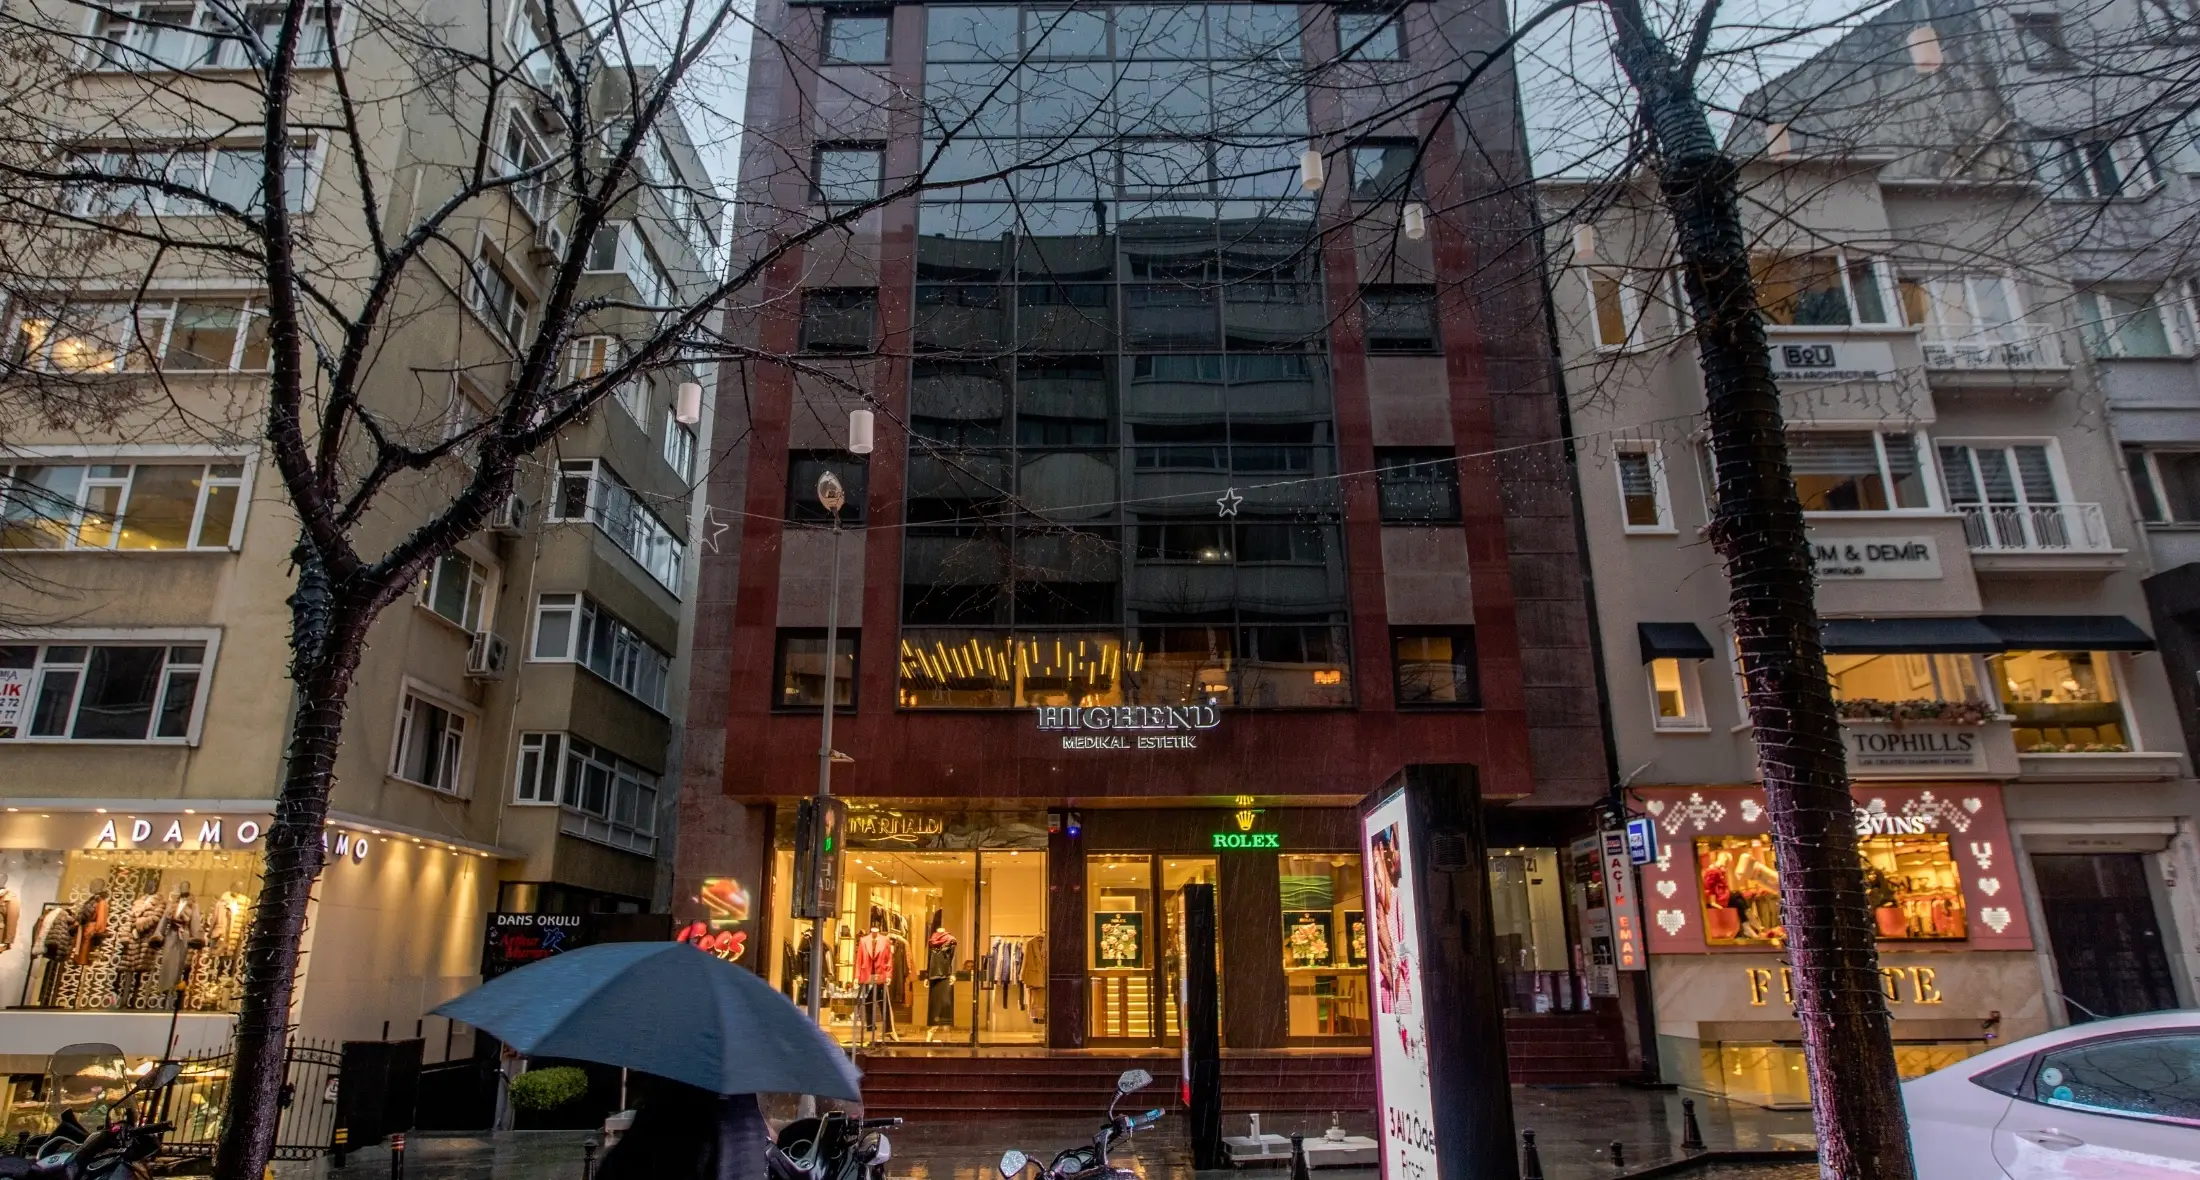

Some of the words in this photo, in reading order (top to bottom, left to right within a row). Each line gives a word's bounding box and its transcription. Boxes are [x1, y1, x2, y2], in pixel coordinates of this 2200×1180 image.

[1866, 541, 1929, 560] DEMİR
[0, 683, 22, 696] IK
[1037, 705, 1221, 729] HIGHEND
[1852, 733, 1972, 752] TOPHILLS
[97, 819, 261, 843] ADAMO
[1212, 833, 1280, 848] ROLEX
[497, 915, 533, 926] DANS
[537, 915, 580, 926] OKULU
